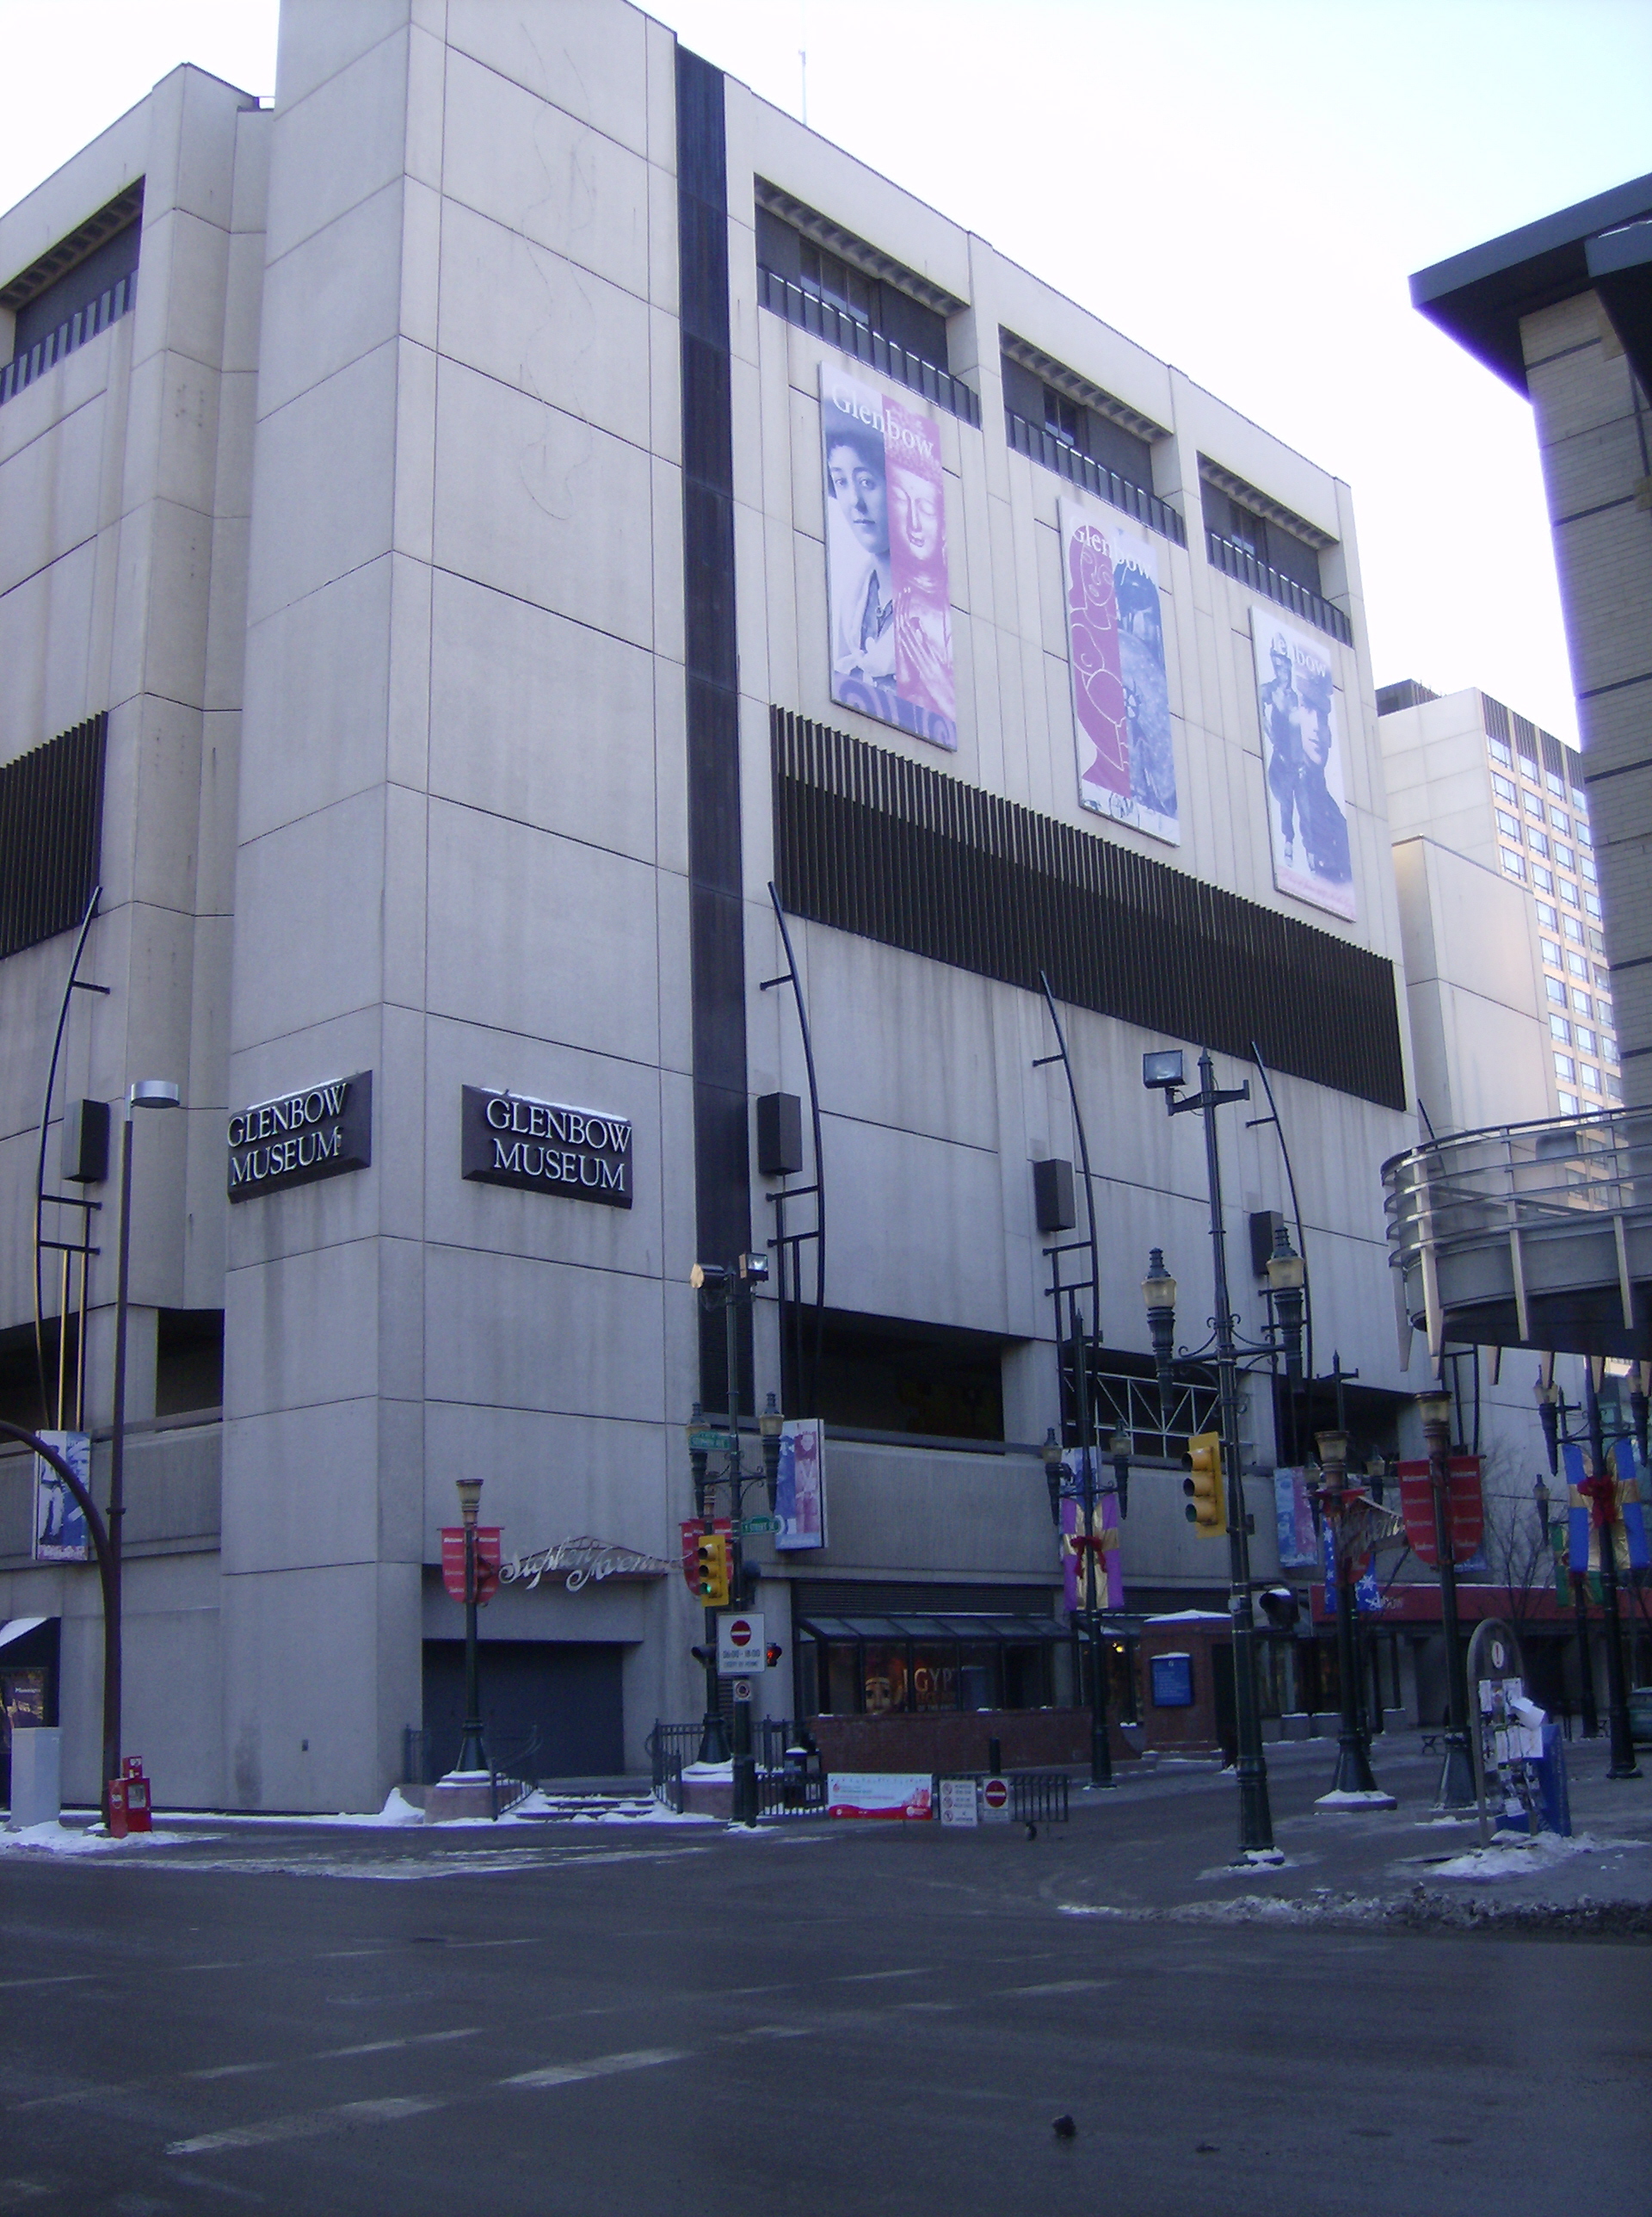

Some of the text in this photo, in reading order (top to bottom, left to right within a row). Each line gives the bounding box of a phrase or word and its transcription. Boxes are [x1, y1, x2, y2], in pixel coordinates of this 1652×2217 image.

[831, 383, 935, 459] Glenbow
[227, 1083, 348, 1148] GLENBOW
[486, 1098, 632, 1153] GLENBOW
[231, 1126, 342, 1186] MUSEUM
[493, 1138, 626, 1191] MUSEUM
